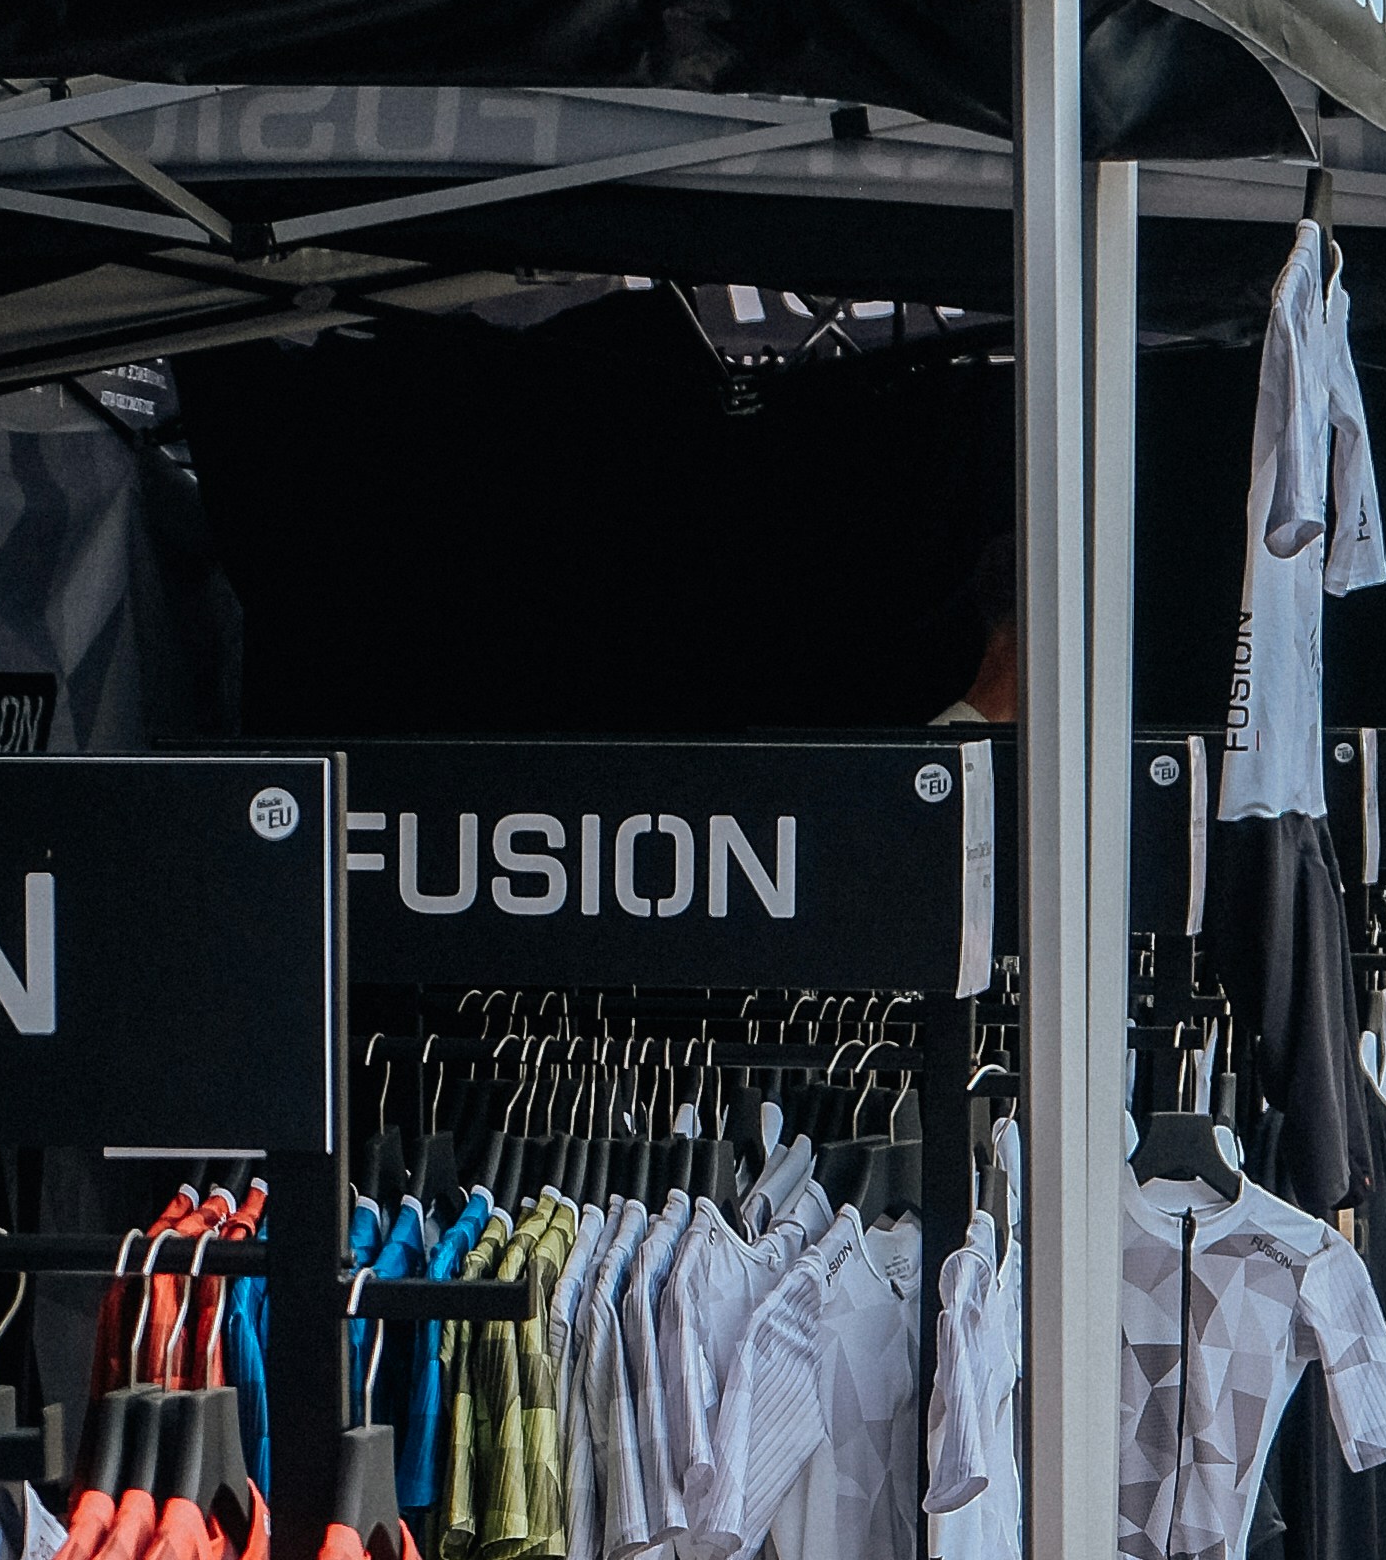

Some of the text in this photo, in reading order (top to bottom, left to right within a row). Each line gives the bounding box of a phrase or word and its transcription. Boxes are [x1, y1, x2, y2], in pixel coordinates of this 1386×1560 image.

[1224, 610, 1254, 753] FUSION
[929, 778, 948, 795] EU
[268, 806, 292, 829] EU
[1250, 1234, 1293, 1270] FUSION
